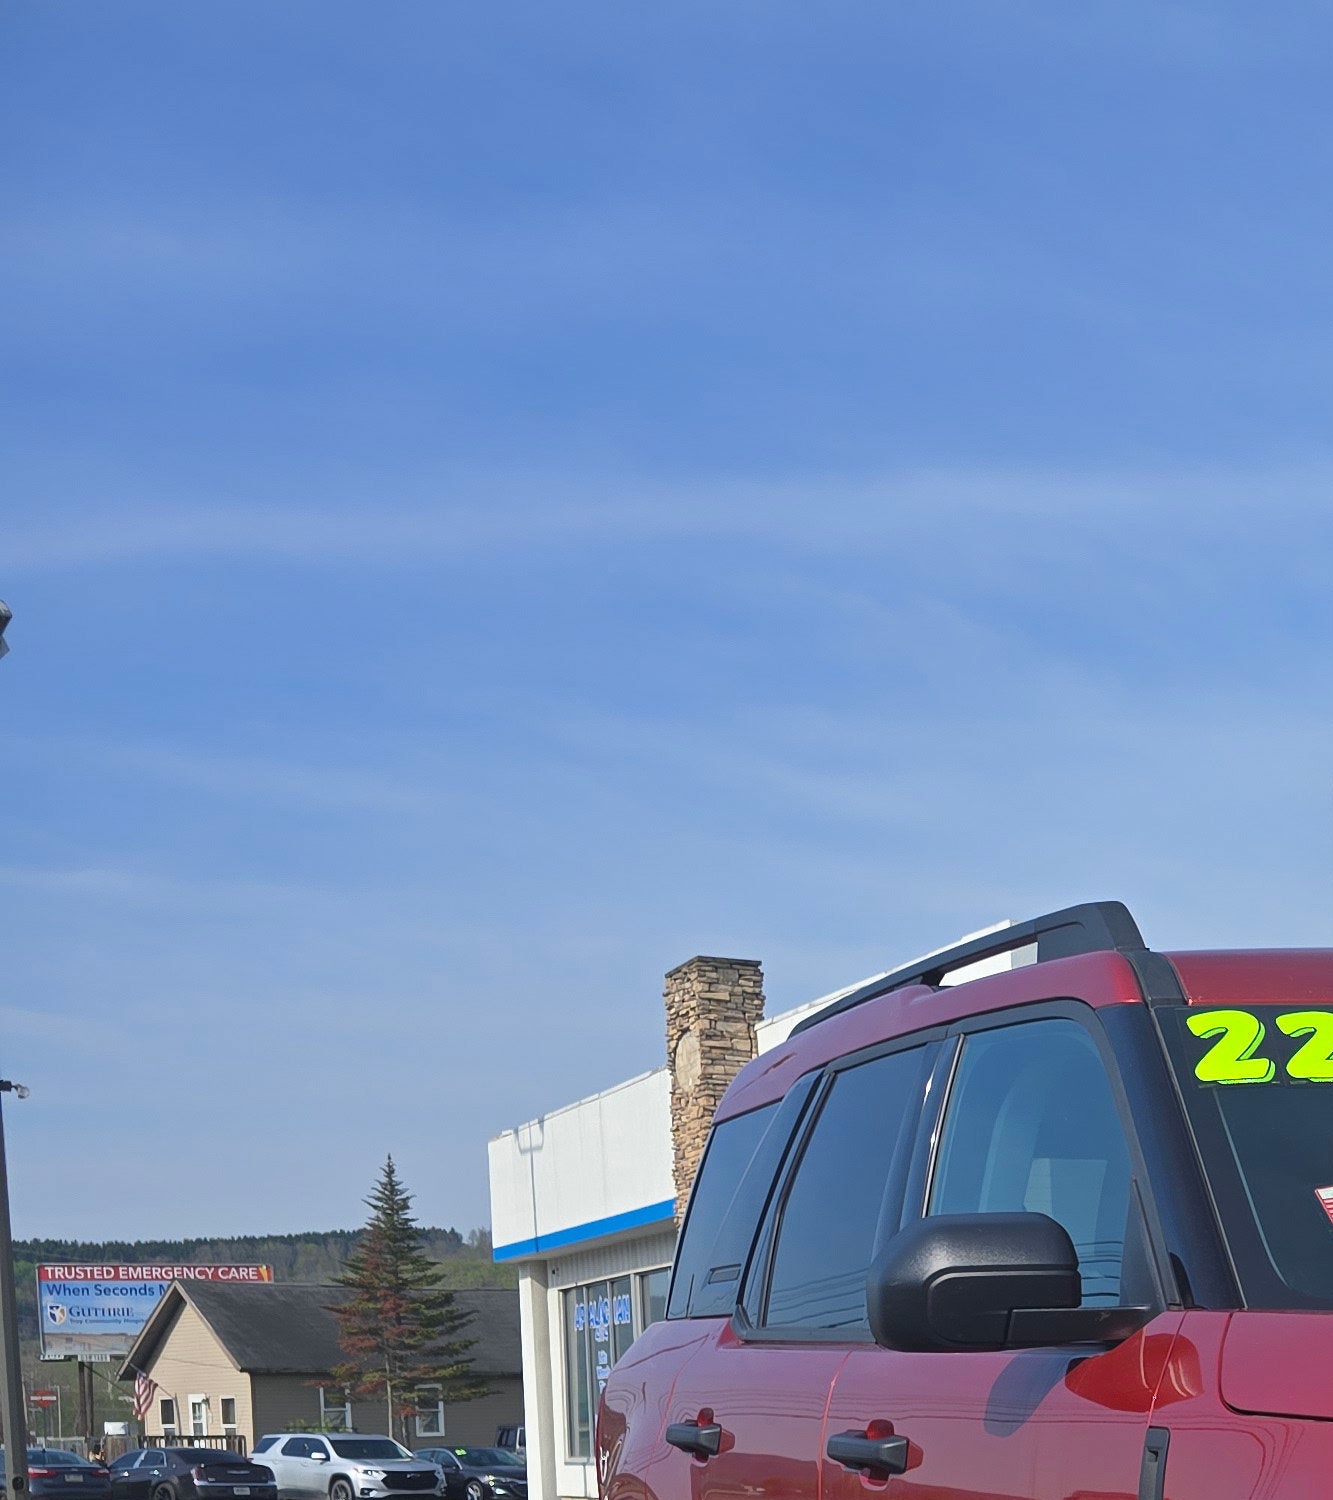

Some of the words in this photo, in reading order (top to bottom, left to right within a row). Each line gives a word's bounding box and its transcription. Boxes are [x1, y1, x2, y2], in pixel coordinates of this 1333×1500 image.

[45, 1267, 115, 1280] TRUSTED
[119, 1267, 214, 1280] EMERGENCY
[218, 1267, 258, 1280] CARE
[46, 1284, 90, 1297] When
[95, 1283, 155, 1297] Seconds
[69, 1306, 133, 1317] GUTHRIE
